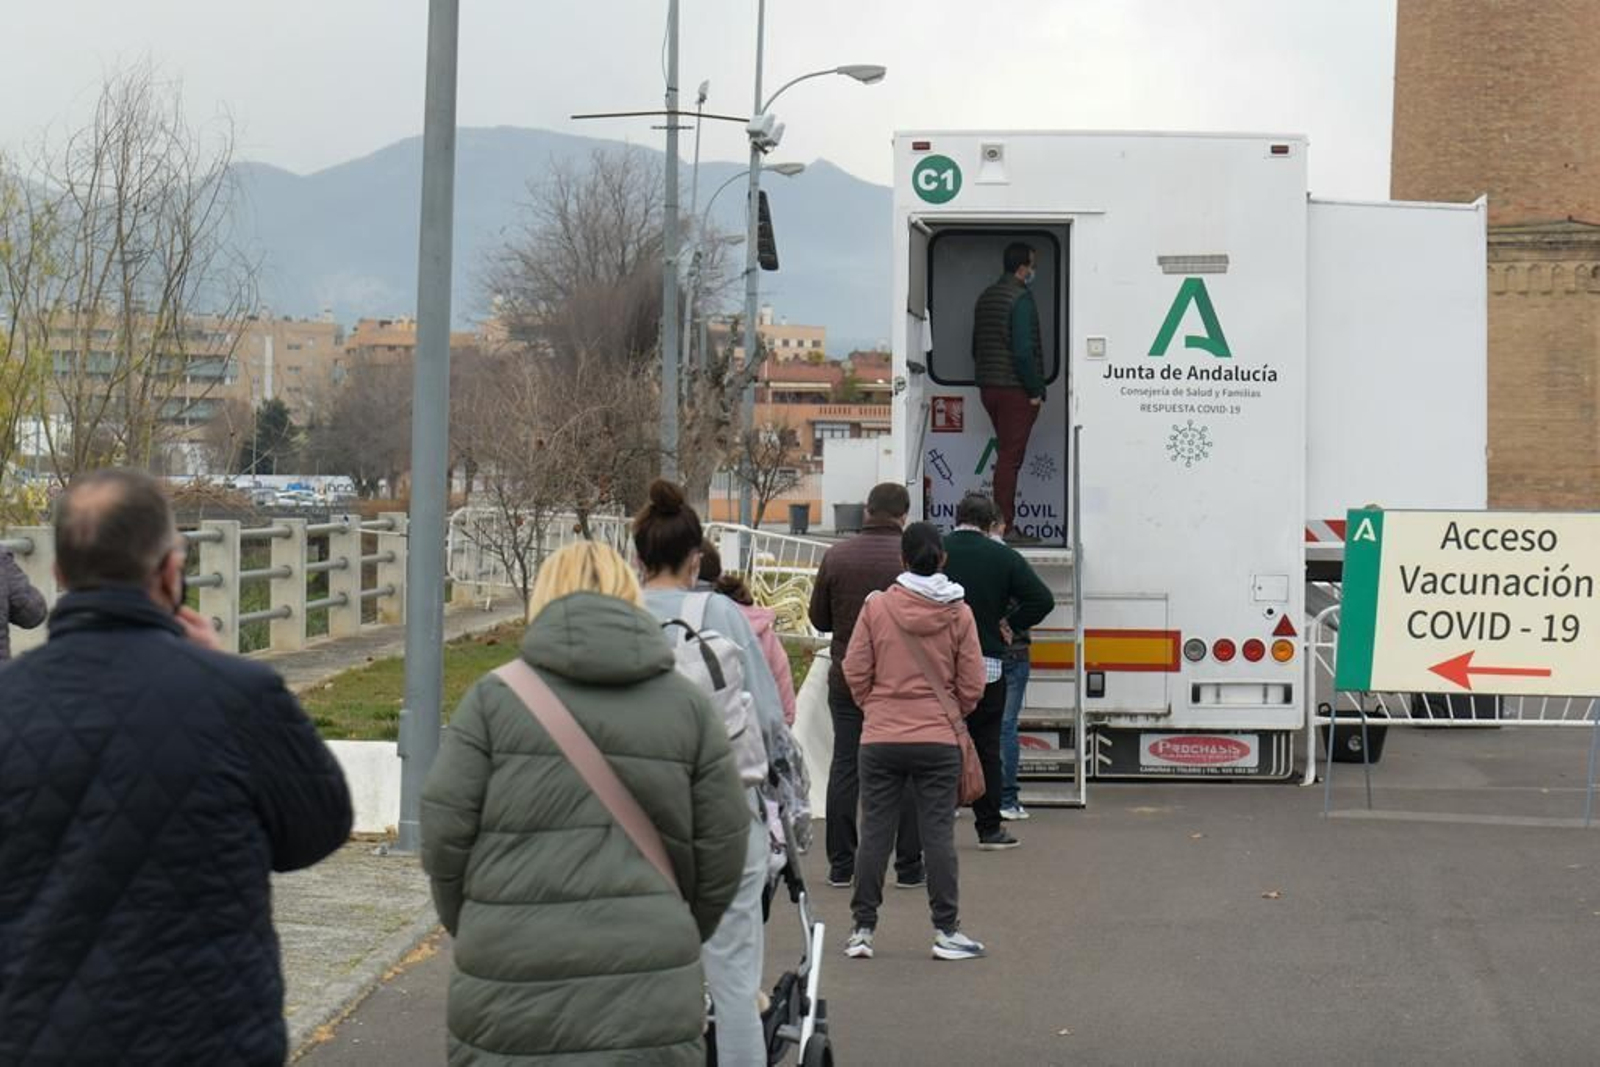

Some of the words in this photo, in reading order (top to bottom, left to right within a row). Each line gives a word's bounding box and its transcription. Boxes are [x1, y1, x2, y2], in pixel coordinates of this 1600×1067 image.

[918, 168, 954, 191] C1
[1103, 364, 1155, 380] Junta
[1160, 365, 1183, 381] de
[1187, 364, 1278, 382] Andalucía
[1120, 386, 1170, 398] Consejería
[1172, 387, 1184, 397] de
[1186, 387, 1213, 398] Salud
[1214, 389, 1221, 399] y
[1222, 388, 1261, 398] Familias
[1140, 403, 1195, 414] RESPUESTA
[1017, 500, 1057, 518] ÓVIL
[1440, 521, 1558, 552] Acceso
[1399, 563, 1594, 599] Vacunación
[1407, 610, 1511, 641] COVID
[1541, 614, 1581, 643] 19
